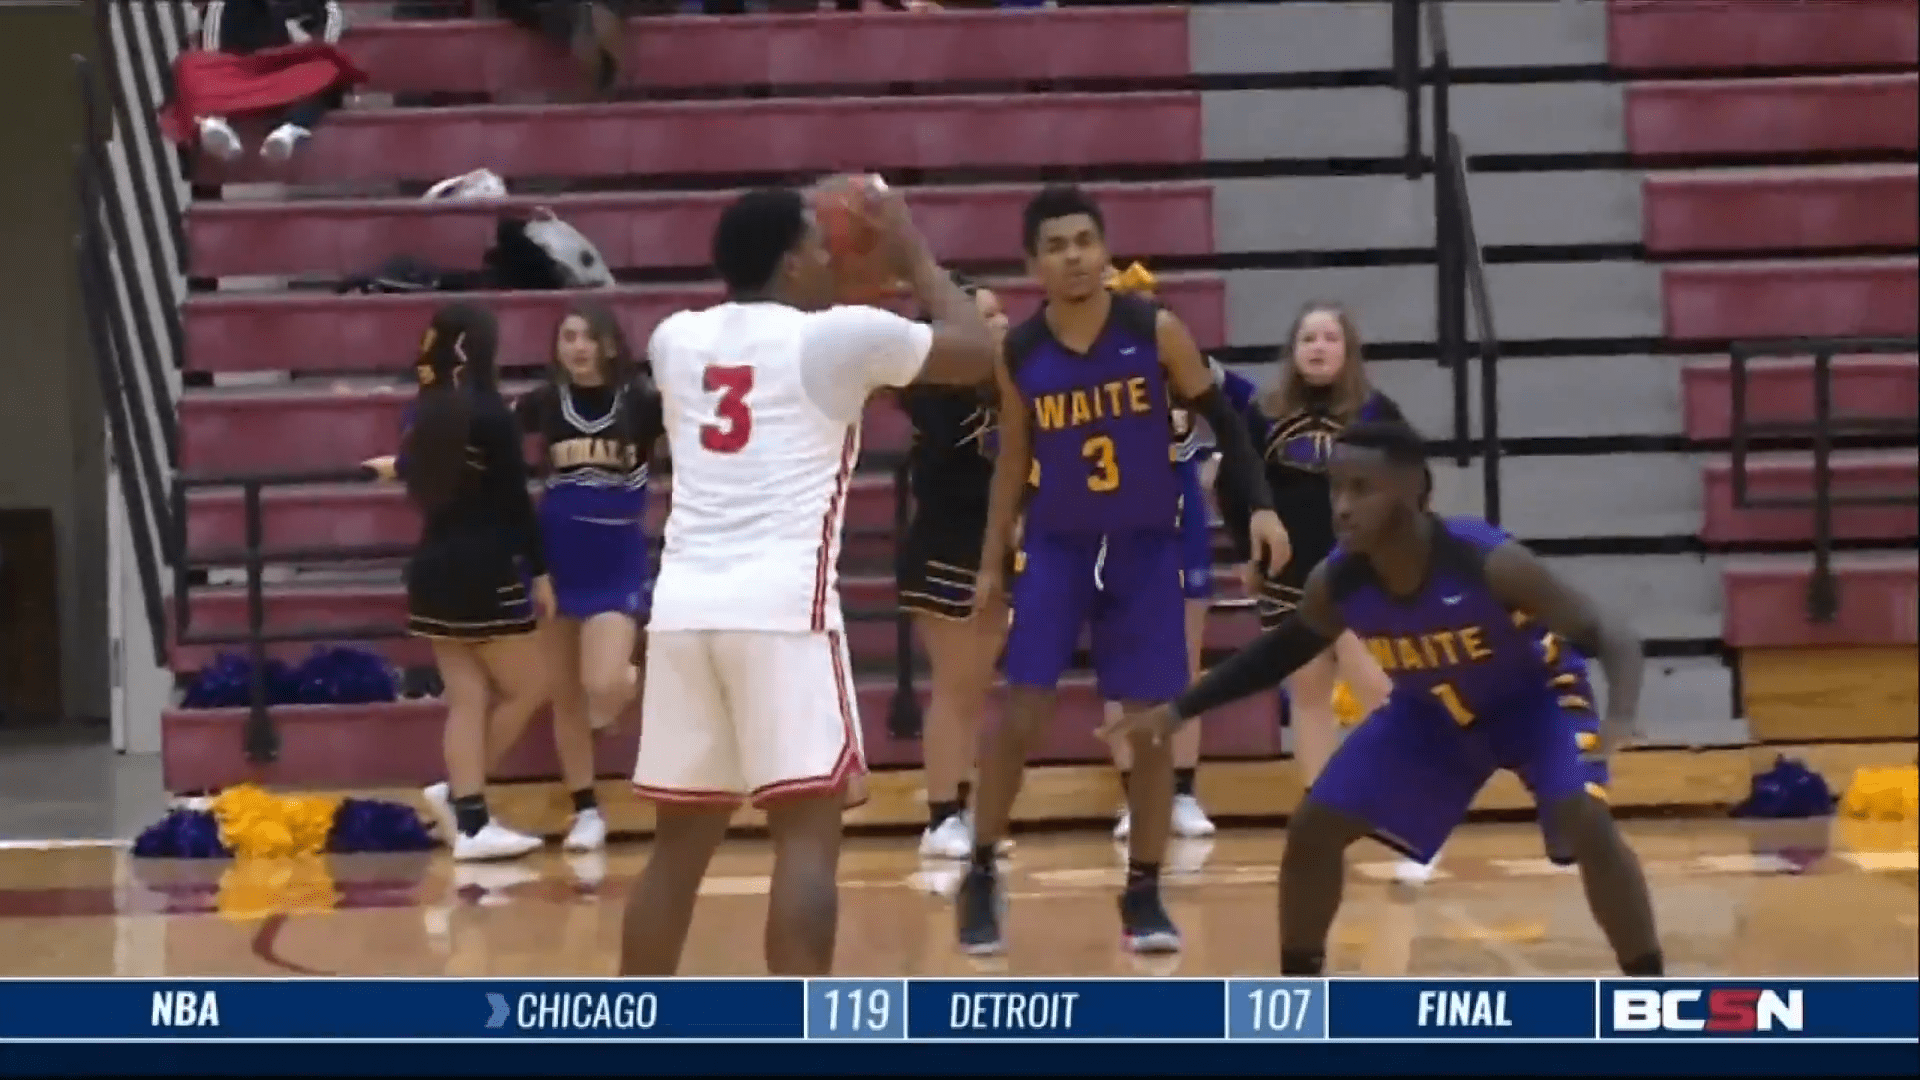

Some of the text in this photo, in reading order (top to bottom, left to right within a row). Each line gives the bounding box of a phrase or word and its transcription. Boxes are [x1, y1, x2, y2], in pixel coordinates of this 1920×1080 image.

[699, 364, 753, 454] 3
[1034, 376, 1151, 430] WAITE
[1082, 435, 1119, 492] 3
[1430, 683, 1475, 726] 1
